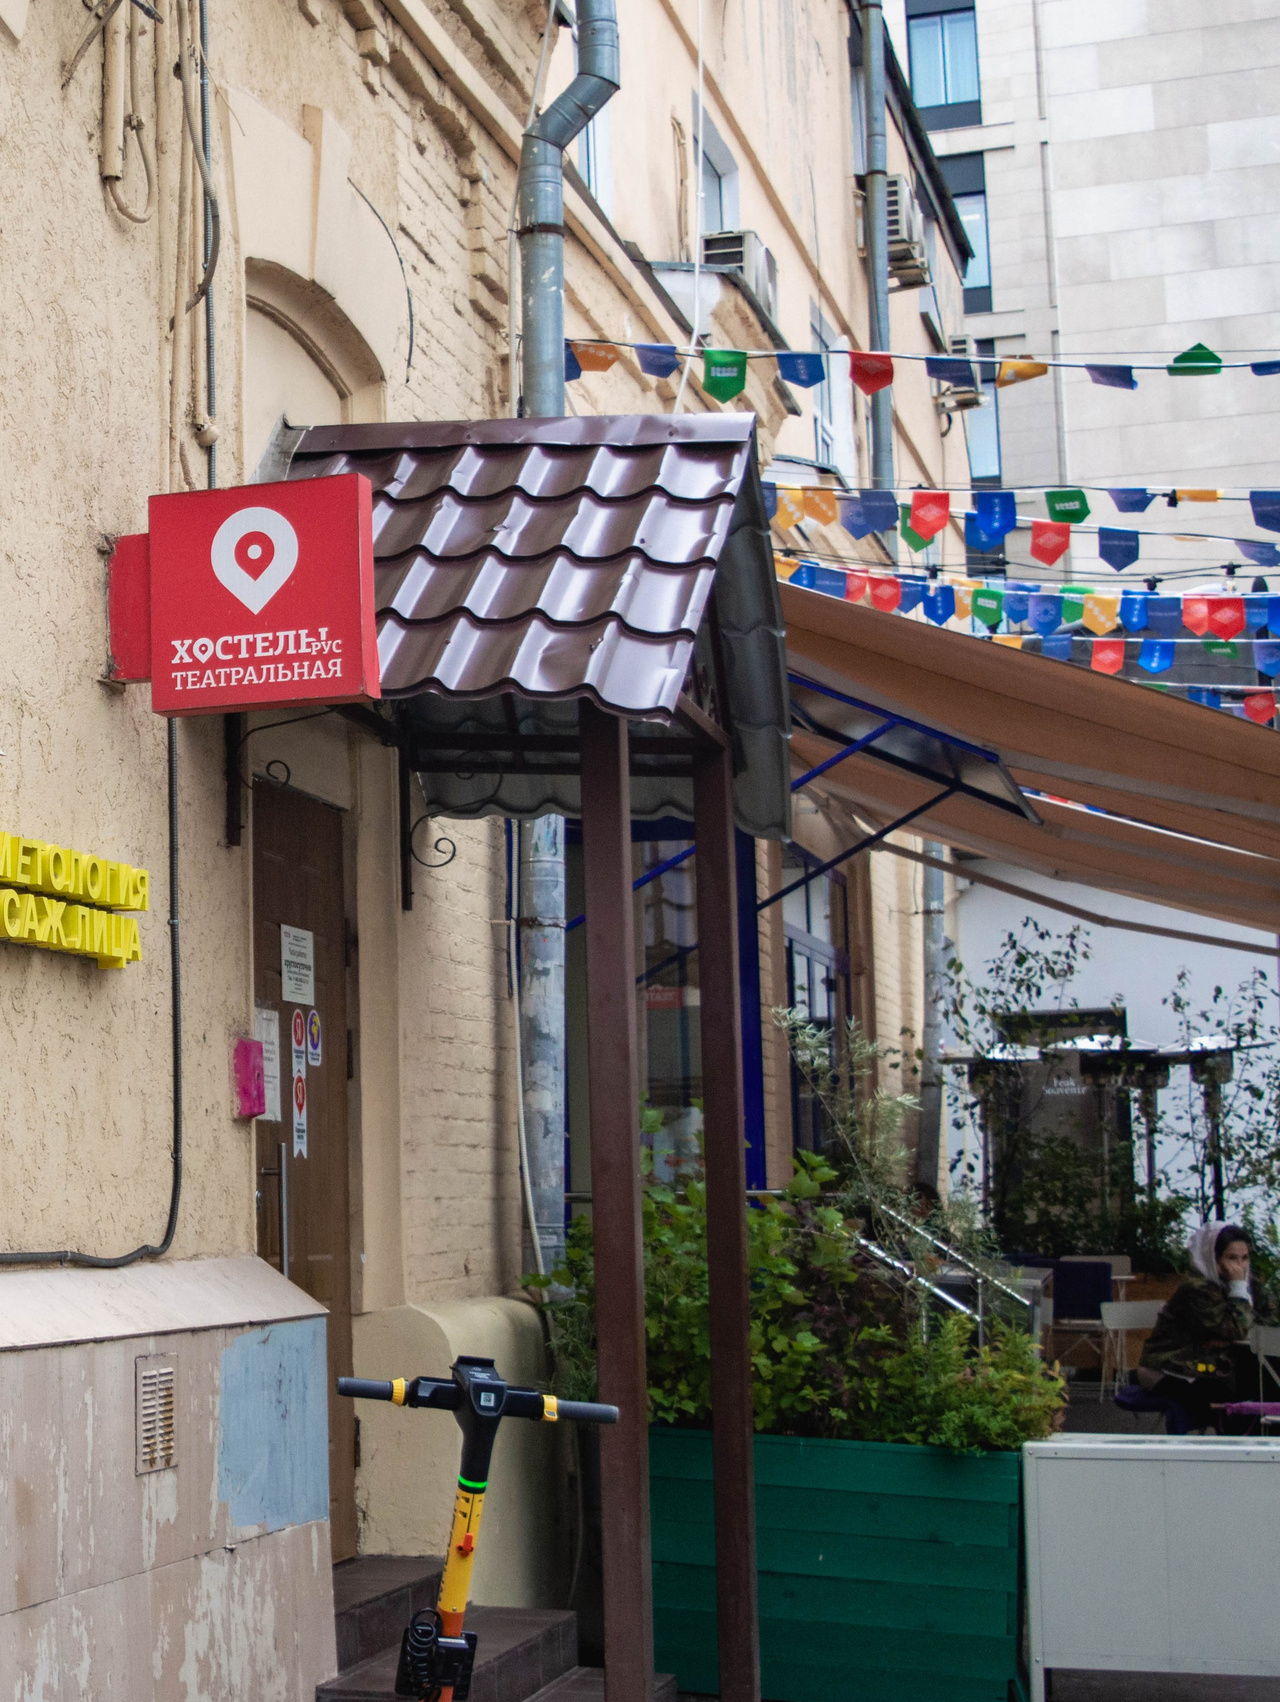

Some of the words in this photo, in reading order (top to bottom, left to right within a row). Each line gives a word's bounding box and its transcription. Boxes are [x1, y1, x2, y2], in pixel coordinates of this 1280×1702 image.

[311, 639, 342, 656] РУС
[171, 658, 343, 691] ТЕАТРАЛЬНАЯ
[75, 904, 143, 969] ЛИЦА
